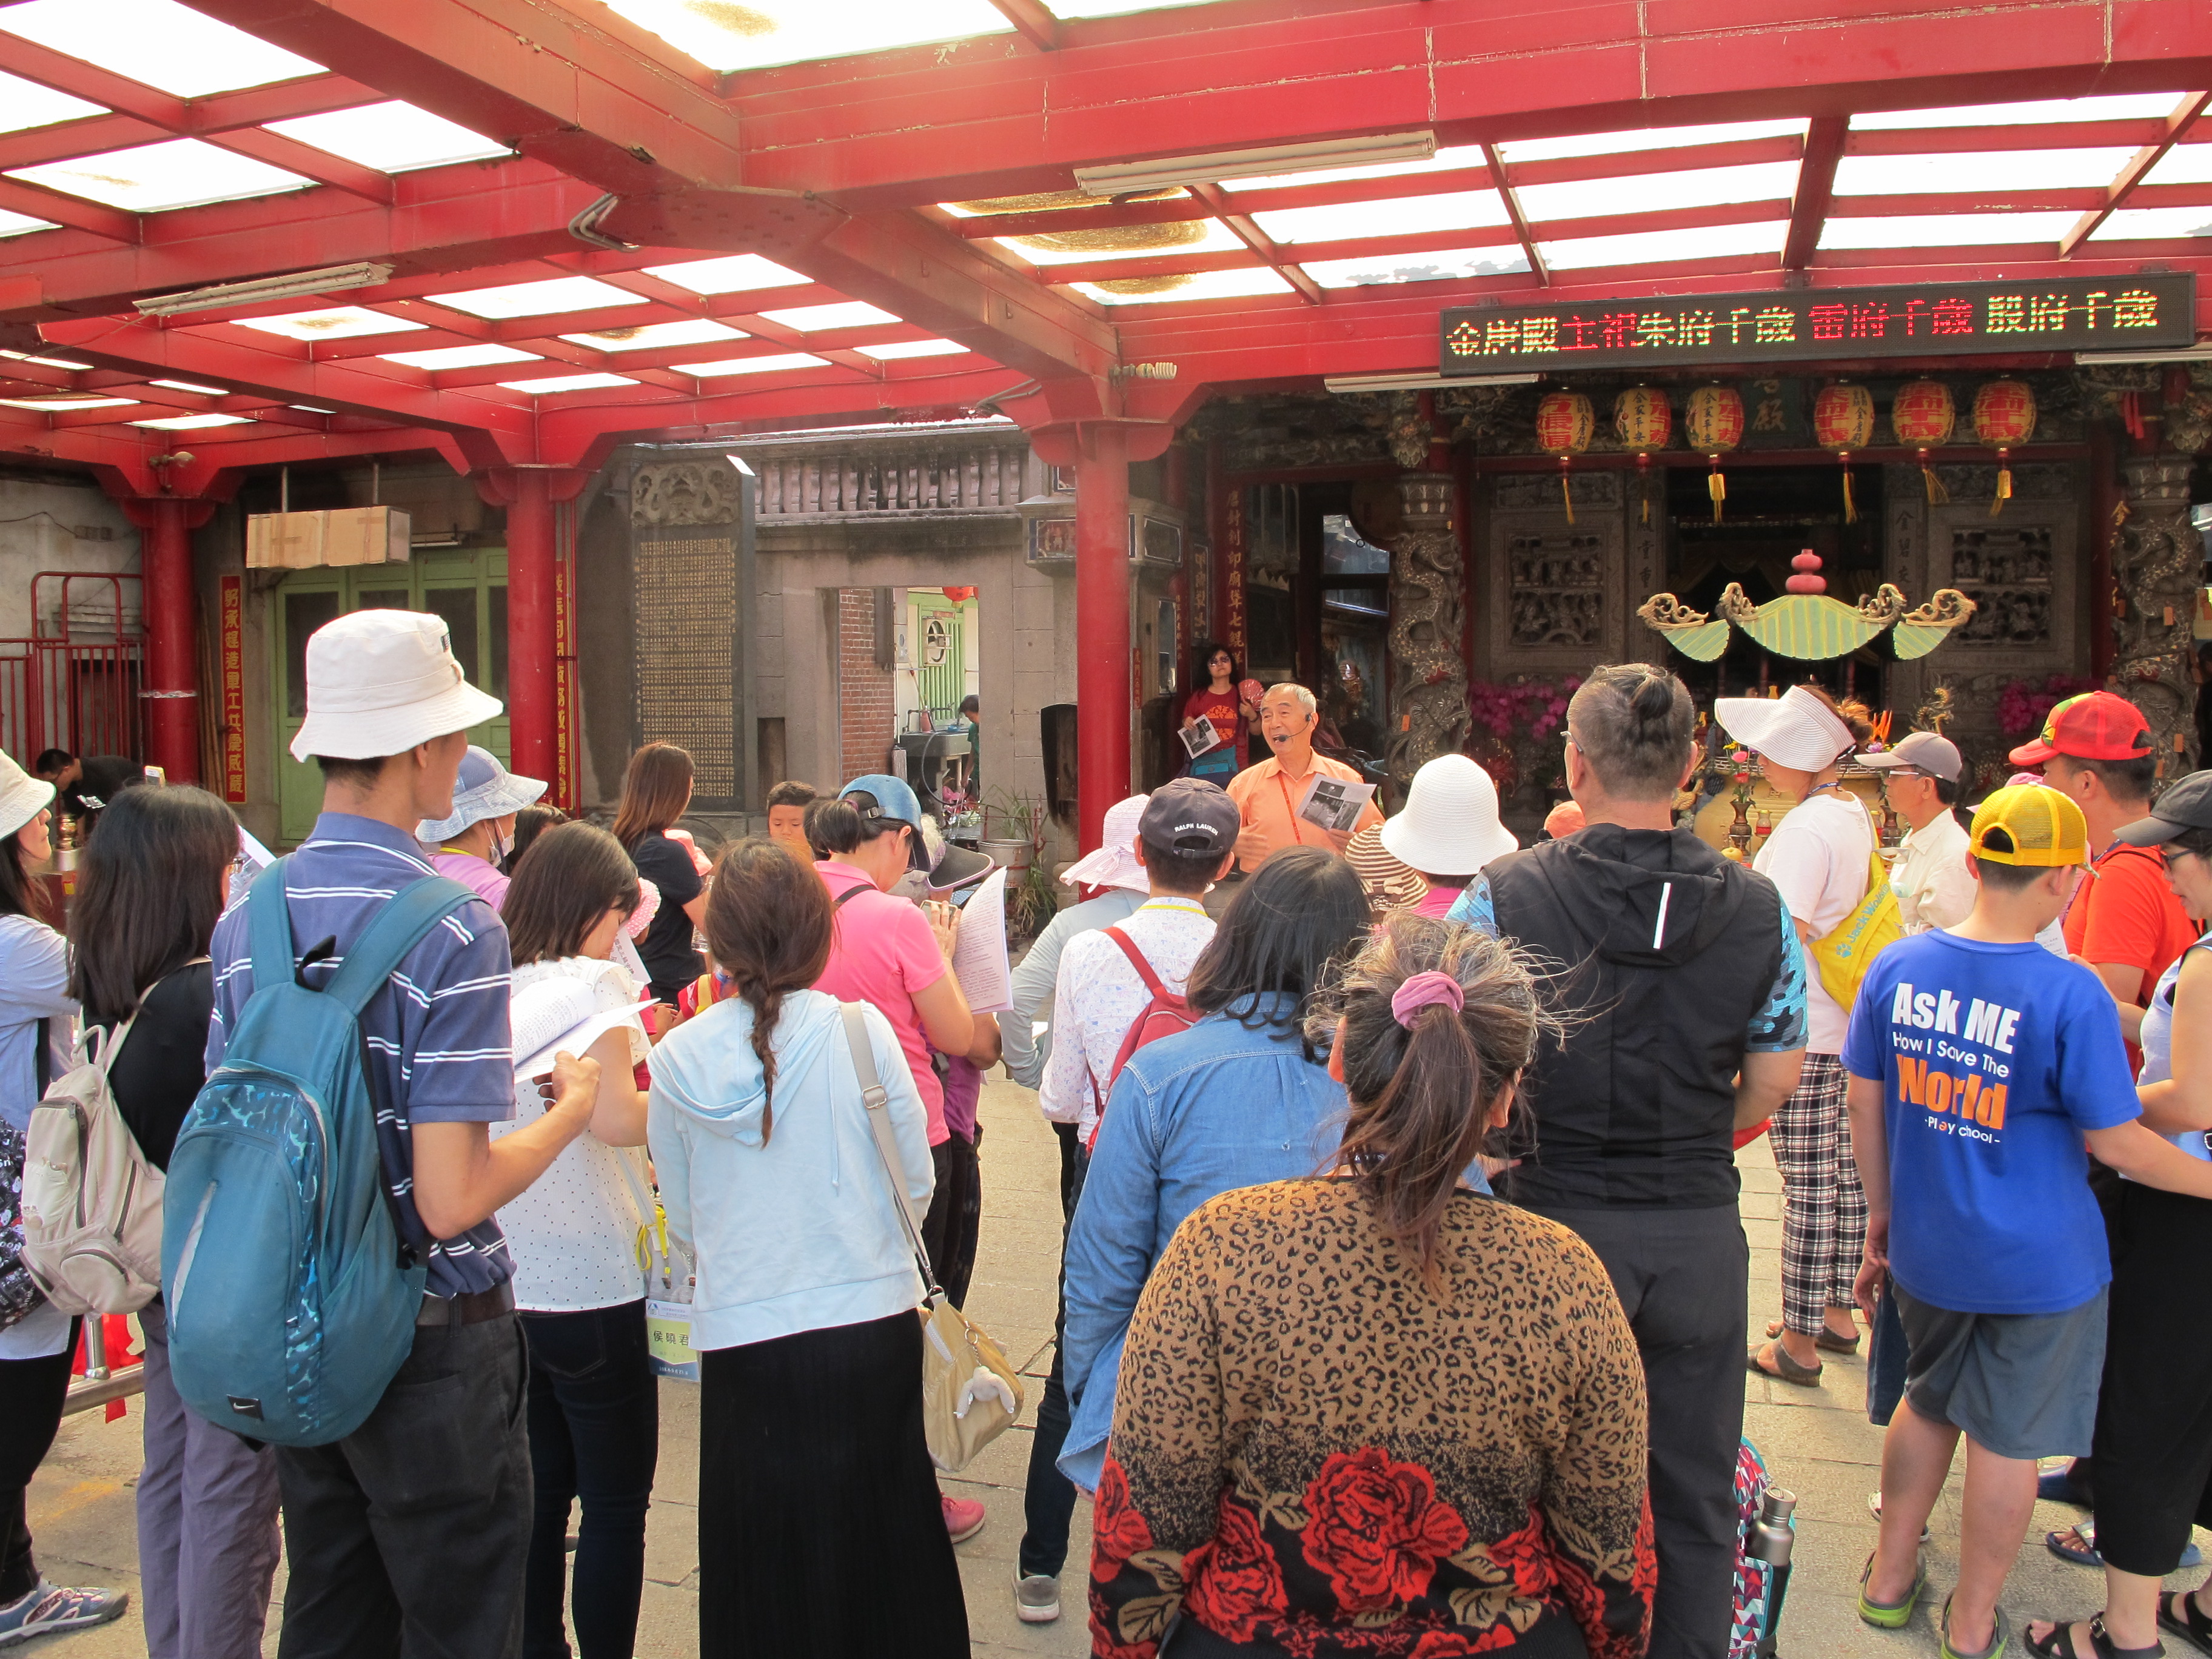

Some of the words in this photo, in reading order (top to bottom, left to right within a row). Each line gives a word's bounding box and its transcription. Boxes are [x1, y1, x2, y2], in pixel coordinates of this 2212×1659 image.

[1175, 823, 1194, 833] RALPH
[1846, 915, 1869, 943] Jack
[1963, 997, 2020, 1054] ME
[1892, 1031, 1923, 1051] How
[1926, 1041, 1932, 1054] I
[1937, 1041, 1977, 1066] Save
[1982, 1053, 2009, 1078] The
[1895, 1053, 2008, 1130] World
[654, 1330, 689, 1346] 侯曉君
